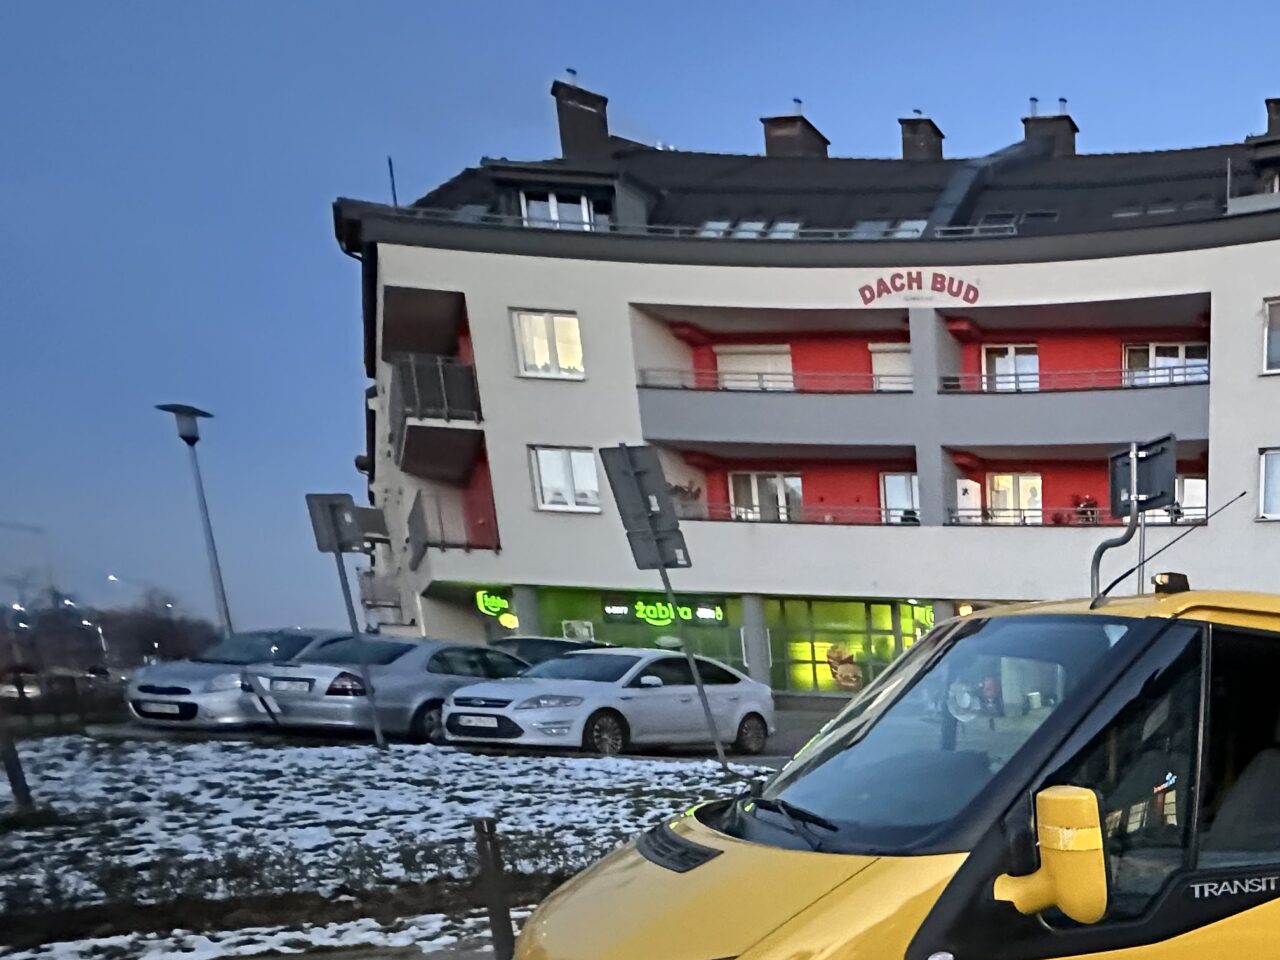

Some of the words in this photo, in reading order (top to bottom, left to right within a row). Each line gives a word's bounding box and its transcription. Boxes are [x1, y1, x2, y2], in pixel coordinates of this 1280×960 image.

[858, 271, 922, 305] DACH
[931, 272, 979, 304] BUD
[1189, 876, 1280, 899] TRANSIT
